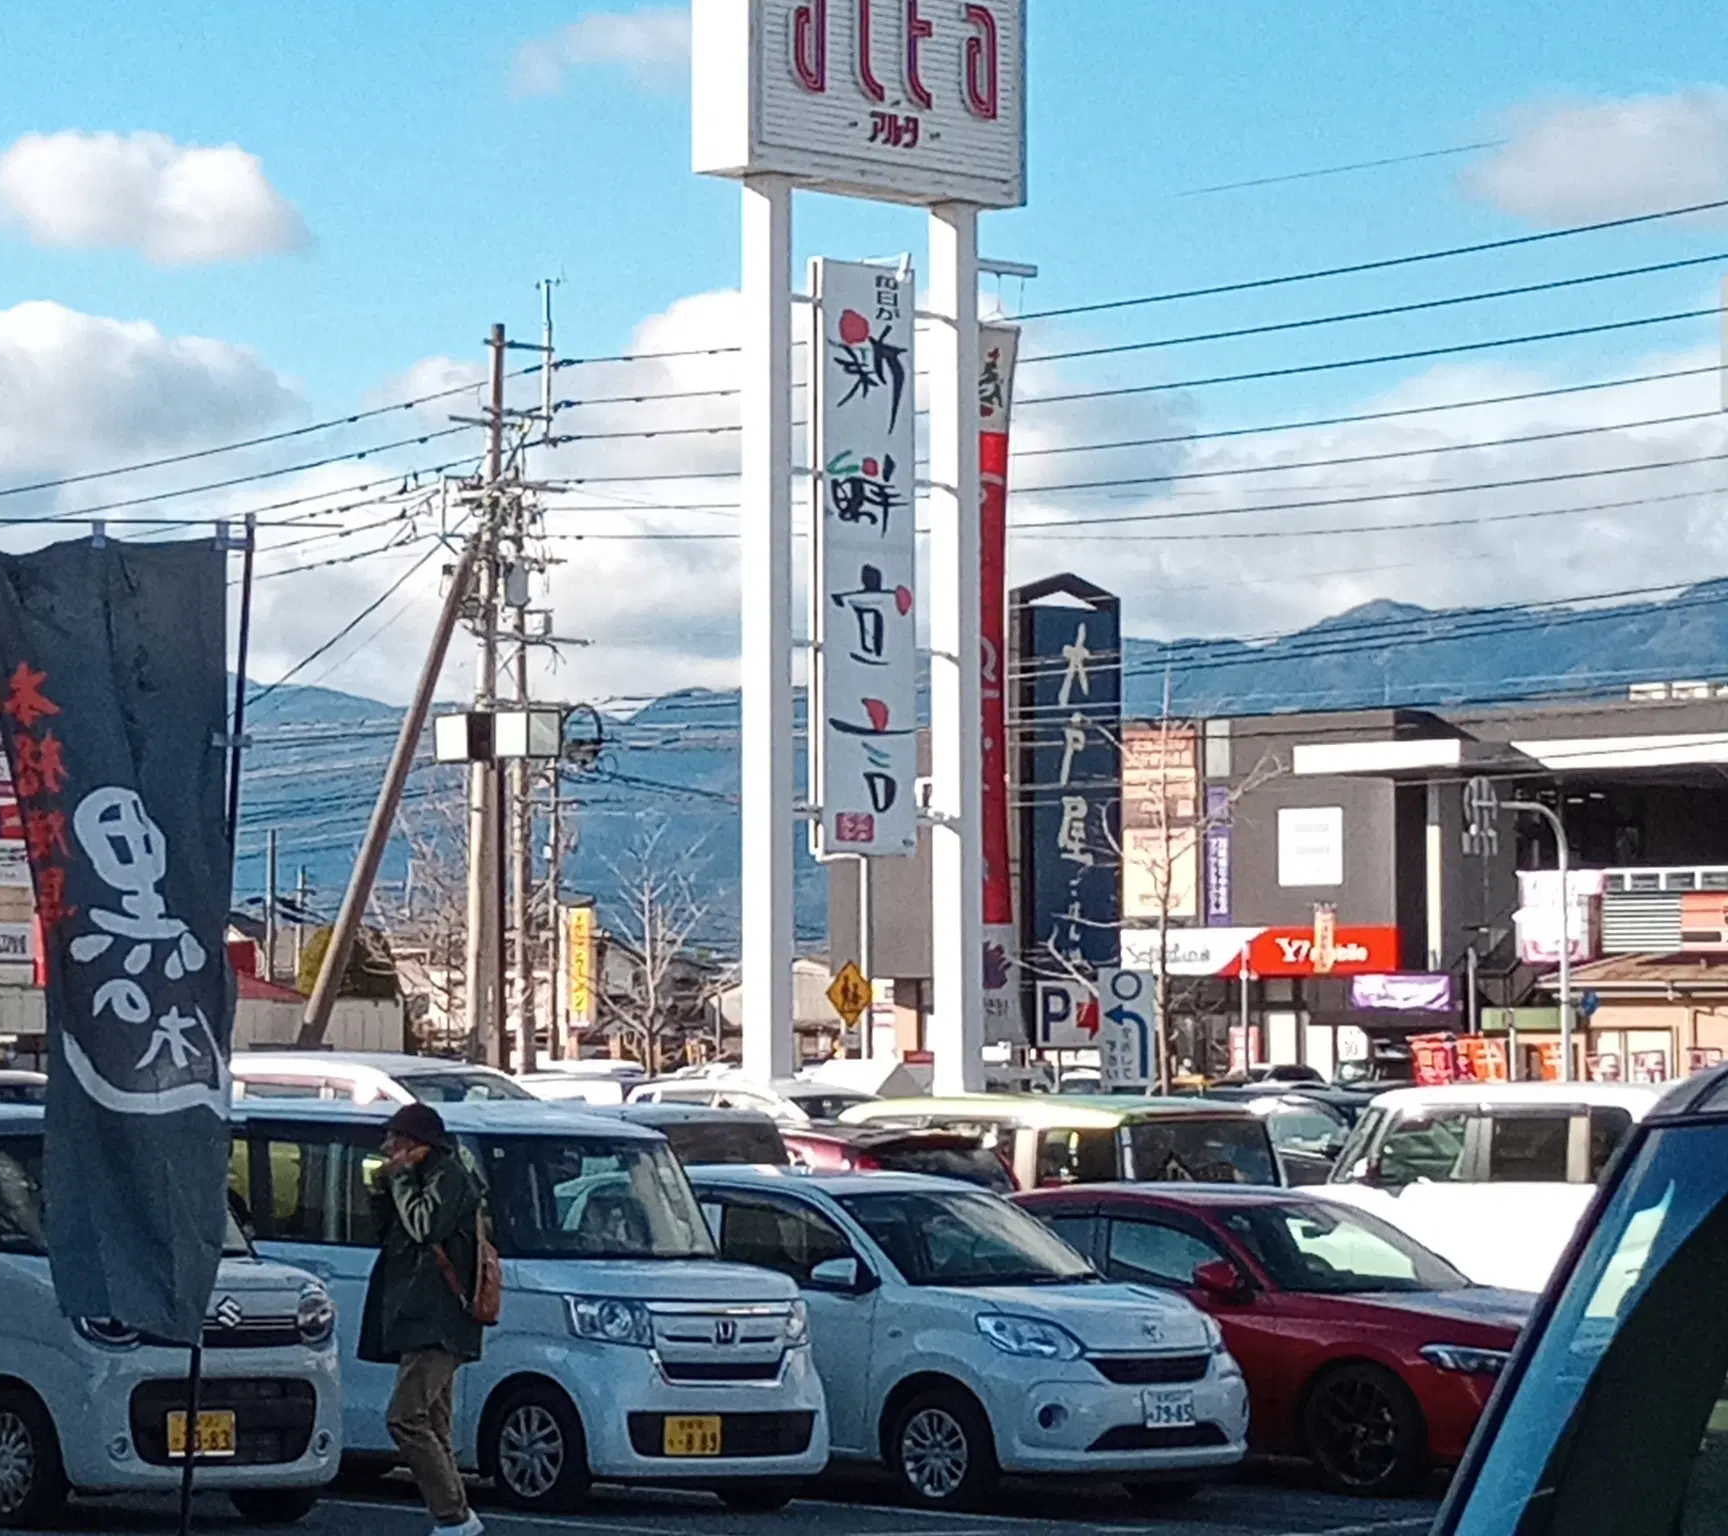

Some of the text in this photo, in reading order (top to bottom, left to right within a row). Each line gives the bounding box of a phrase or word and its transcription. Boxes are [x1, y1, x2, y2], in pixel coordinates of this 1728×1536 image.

[867, 111, 919, 149] アルタ
[1041, 985, 1072, 1043] P
